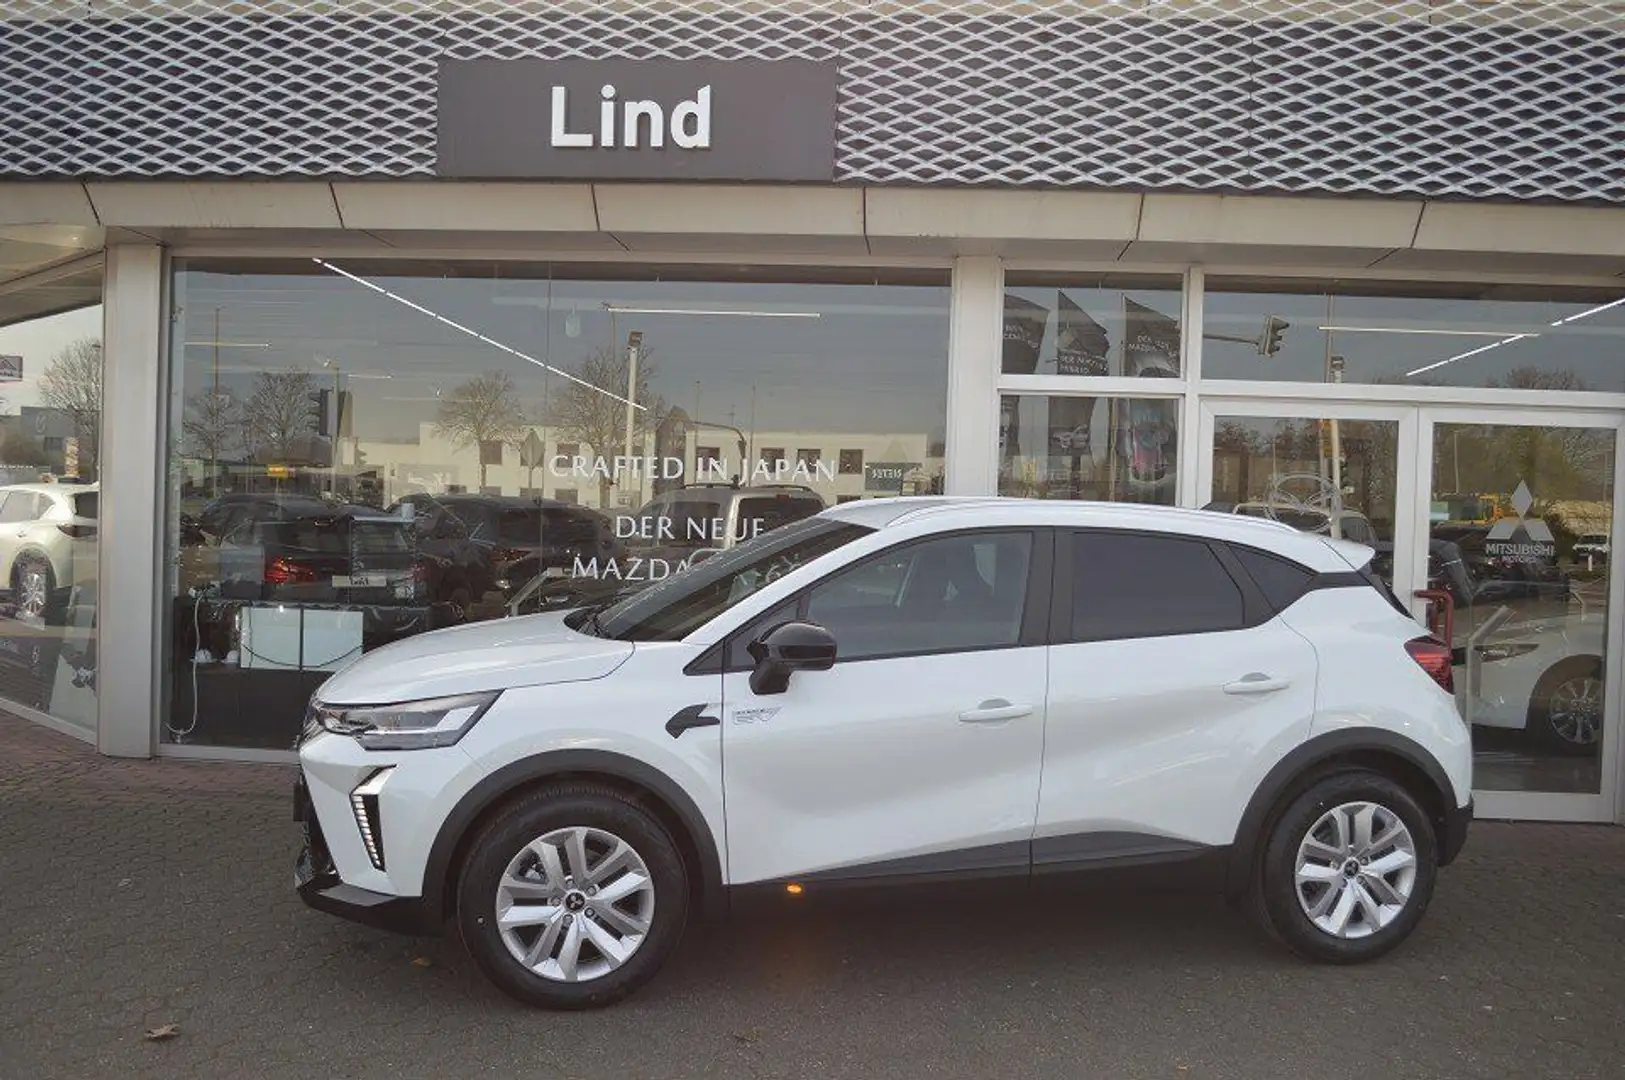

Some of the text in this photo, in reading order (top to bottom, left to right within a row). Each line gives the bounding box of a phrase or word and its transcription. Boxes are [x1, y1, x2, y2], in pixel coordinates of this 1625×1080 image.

[552, 84, 711, 148] Lind
[549, 455, 837, 488] CRAFTED IN JAPAN
[615, 515, 676, 541] DER
[1486, 543, 1556, 557] MITSUBISHI
